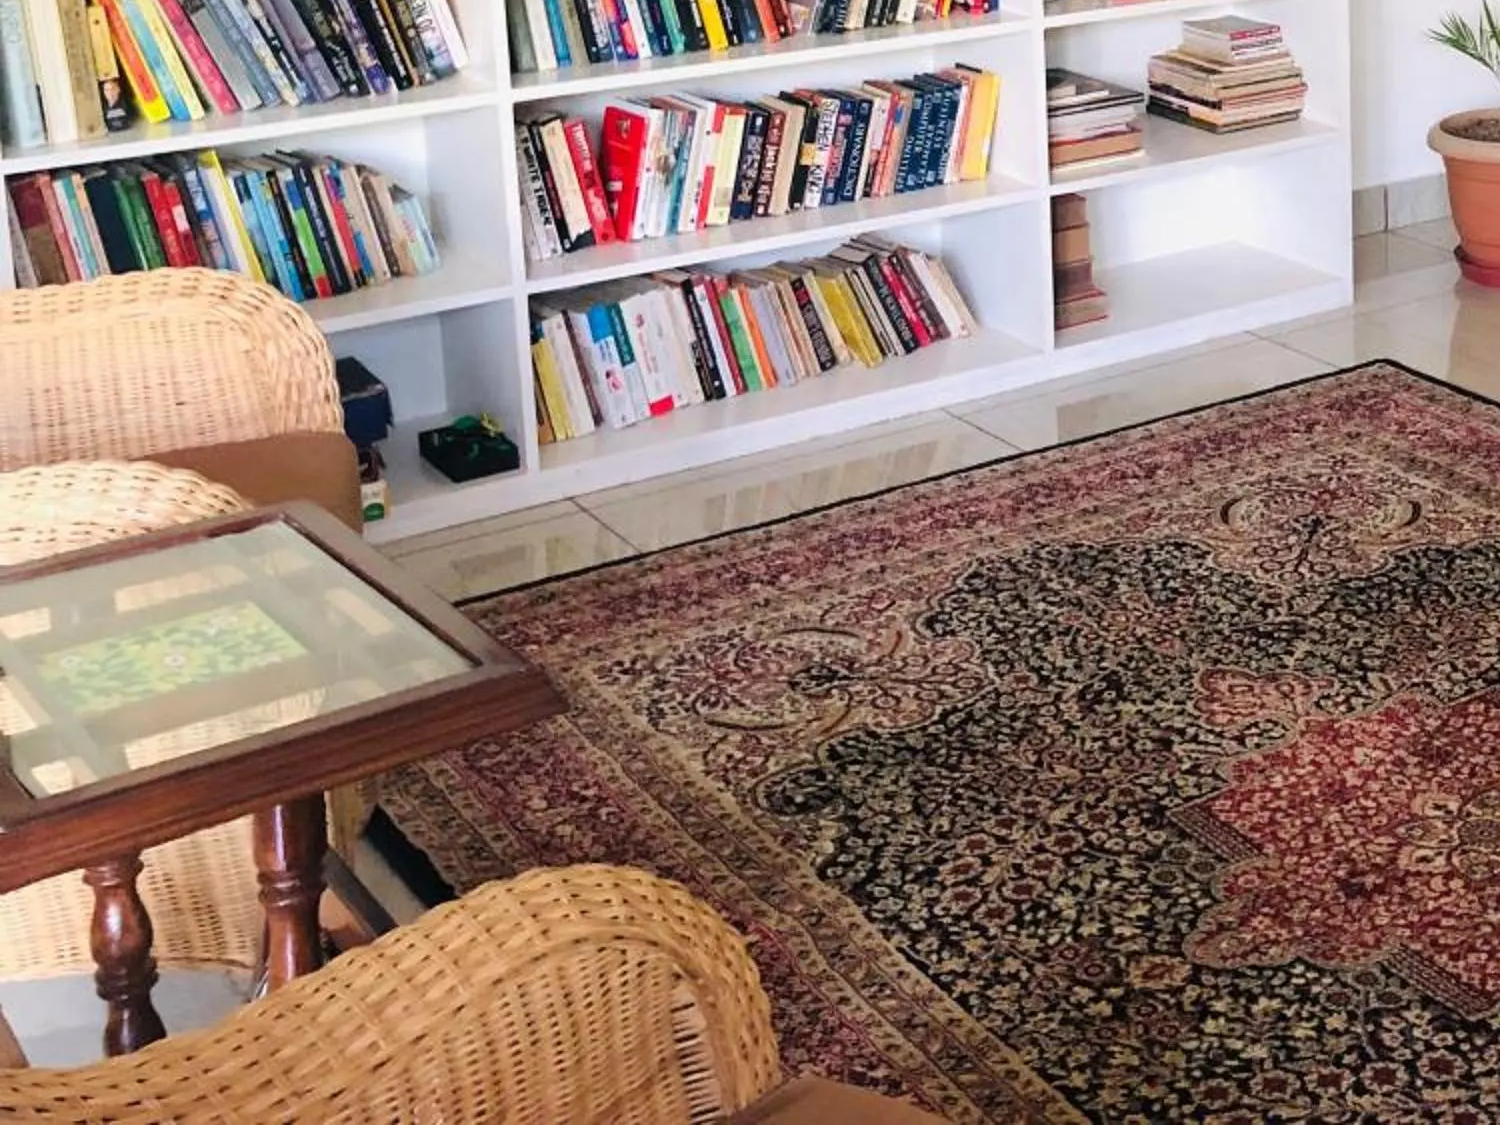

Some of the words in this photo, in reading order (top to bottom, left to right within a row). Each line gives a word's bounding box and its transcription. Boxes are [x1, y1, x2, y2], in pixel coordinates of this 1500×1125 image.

[816, 99, 838, 152] STEPHEN
[915, 94, 934, 153] COMPUTER
[934, 90, 954, 148] BUSINESS
[843, 122, 867, 196] DICTIONARY
[895, 135, 915, 192] SPELLING
[918, 124, 935, 185] GRAMMAR
[522, 143, 541, 183] WHITE
[533, 184, 553, 226] TIGER
